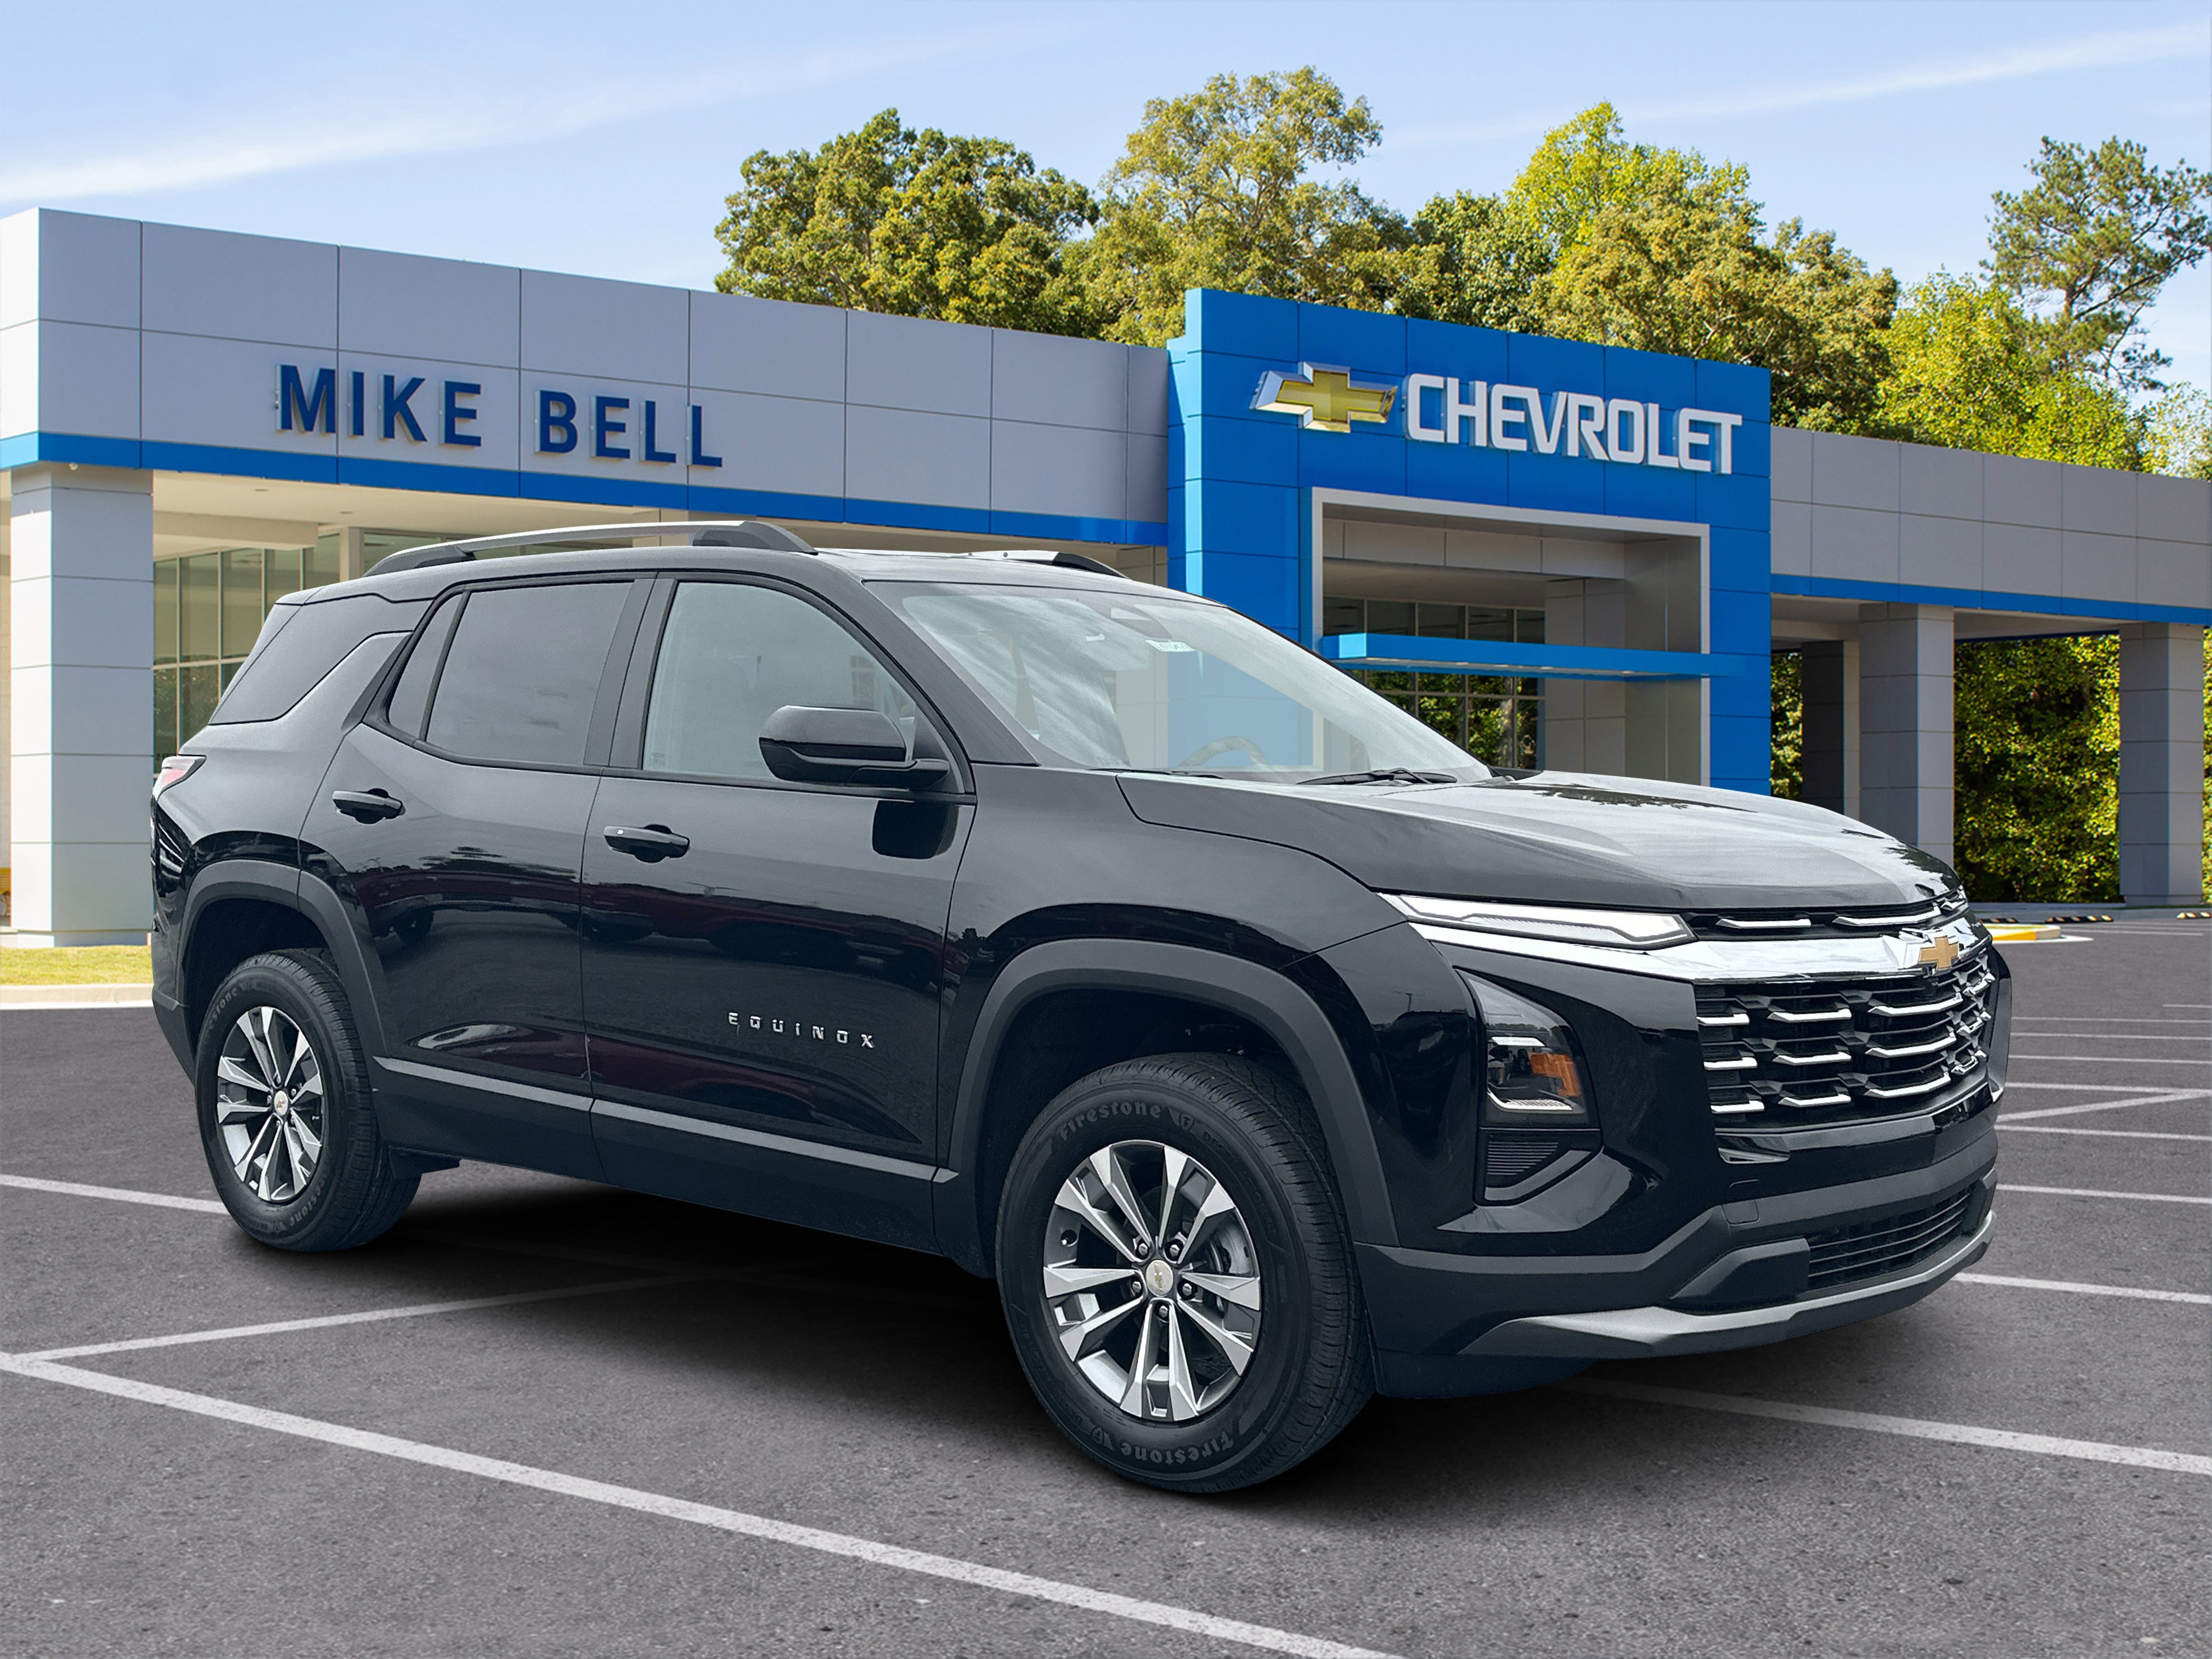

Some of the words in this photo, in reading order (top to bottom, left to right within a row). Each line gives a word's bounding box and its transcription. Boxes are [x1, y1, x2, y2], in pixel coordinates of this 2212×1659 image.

[278, 364, 482, 447] MIKE
[536, 390, 723, 467] BELL
[1403, 373, 1742, 475] CHEVROLET
[728, 1012, 873, 1048] EQUINOX
[1056, 1101, 1161, 1141] Firestone
[1120, 1431, 1234, 1464] Firestone
